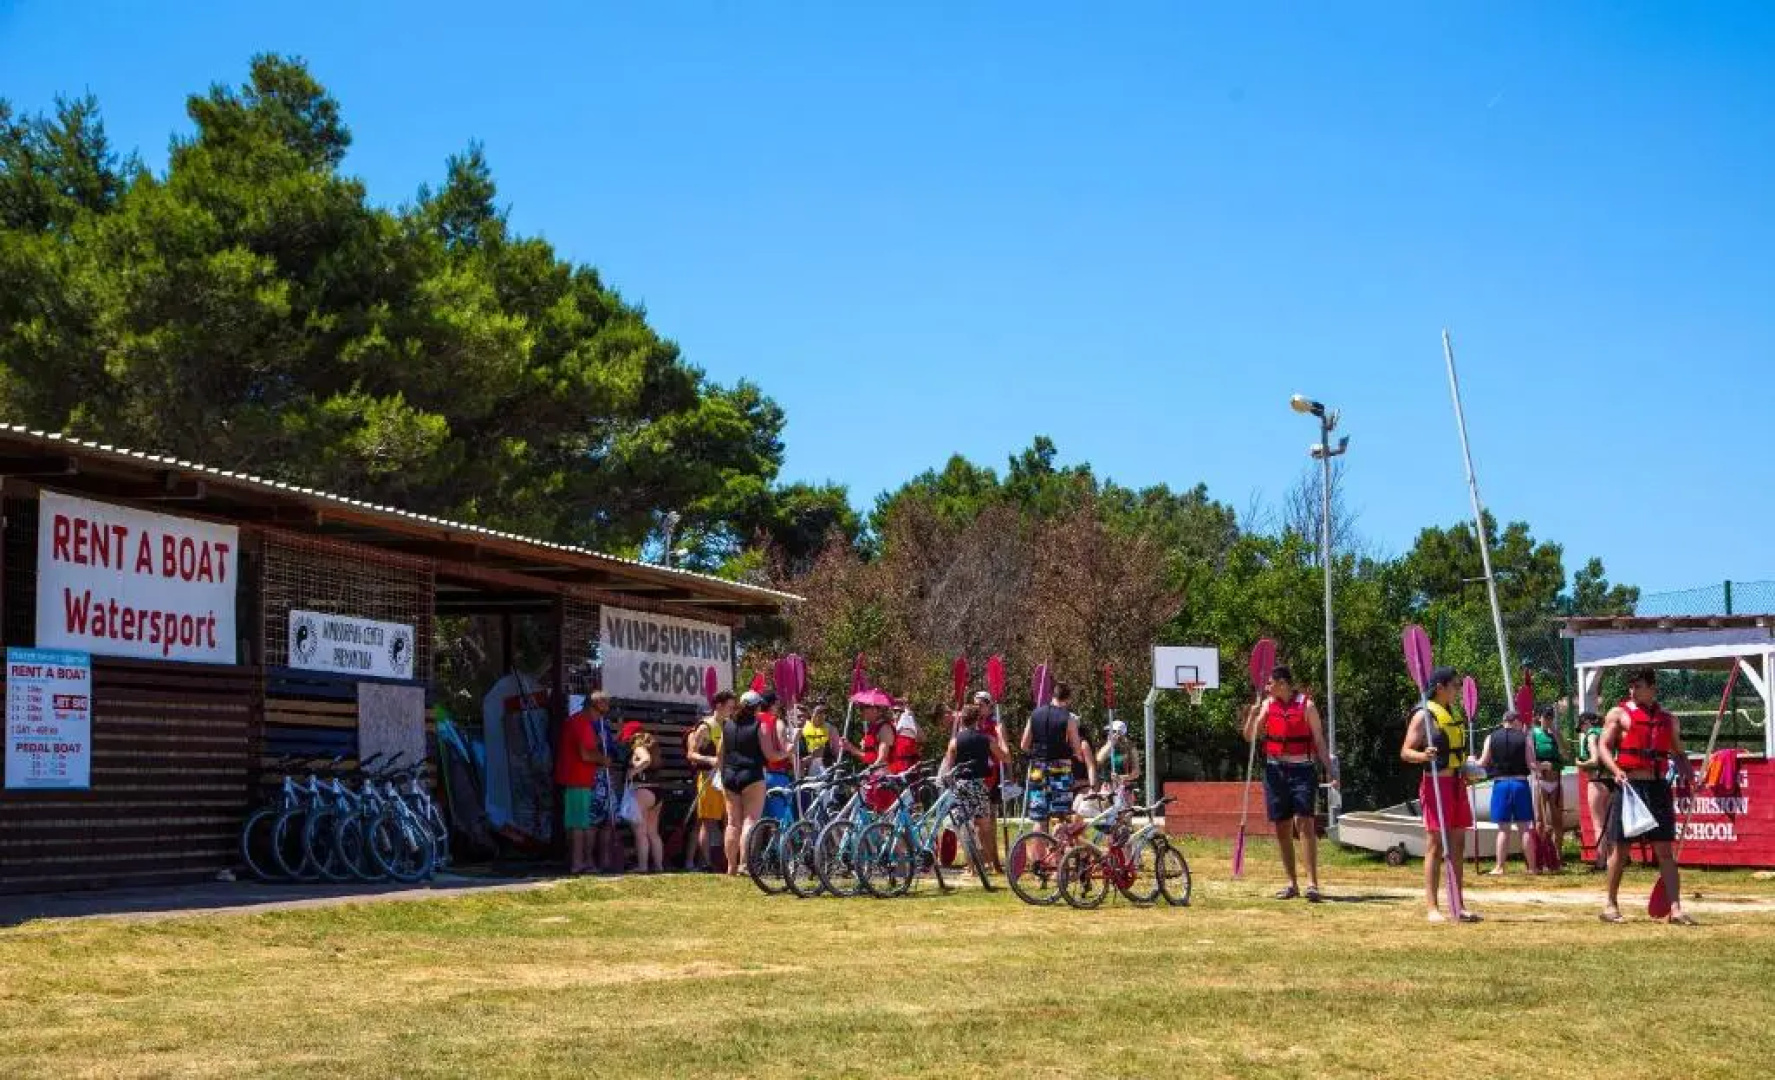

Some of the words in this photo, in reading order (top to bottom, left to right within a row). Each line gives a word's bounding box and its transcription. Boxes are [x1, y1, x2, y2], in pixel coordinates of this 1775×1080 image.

[53, 514, 128, 570] RENT
[135, 530, 153, 575] A
[162, 534, 229, 582] BOAT
[64, 587, 216, 657] Watersport
[606, 616, 729, 662] WINDSURFING
[12, 665, 42, 677] RENT
[46, 667, 54, 679] A
[57, 668, 87, 680] BOAT
[15, 743, 51, 753] PEDAL
[53, 743, 82, 753] BOAT
[1675, 822, 1738, 840] SCHOOL
